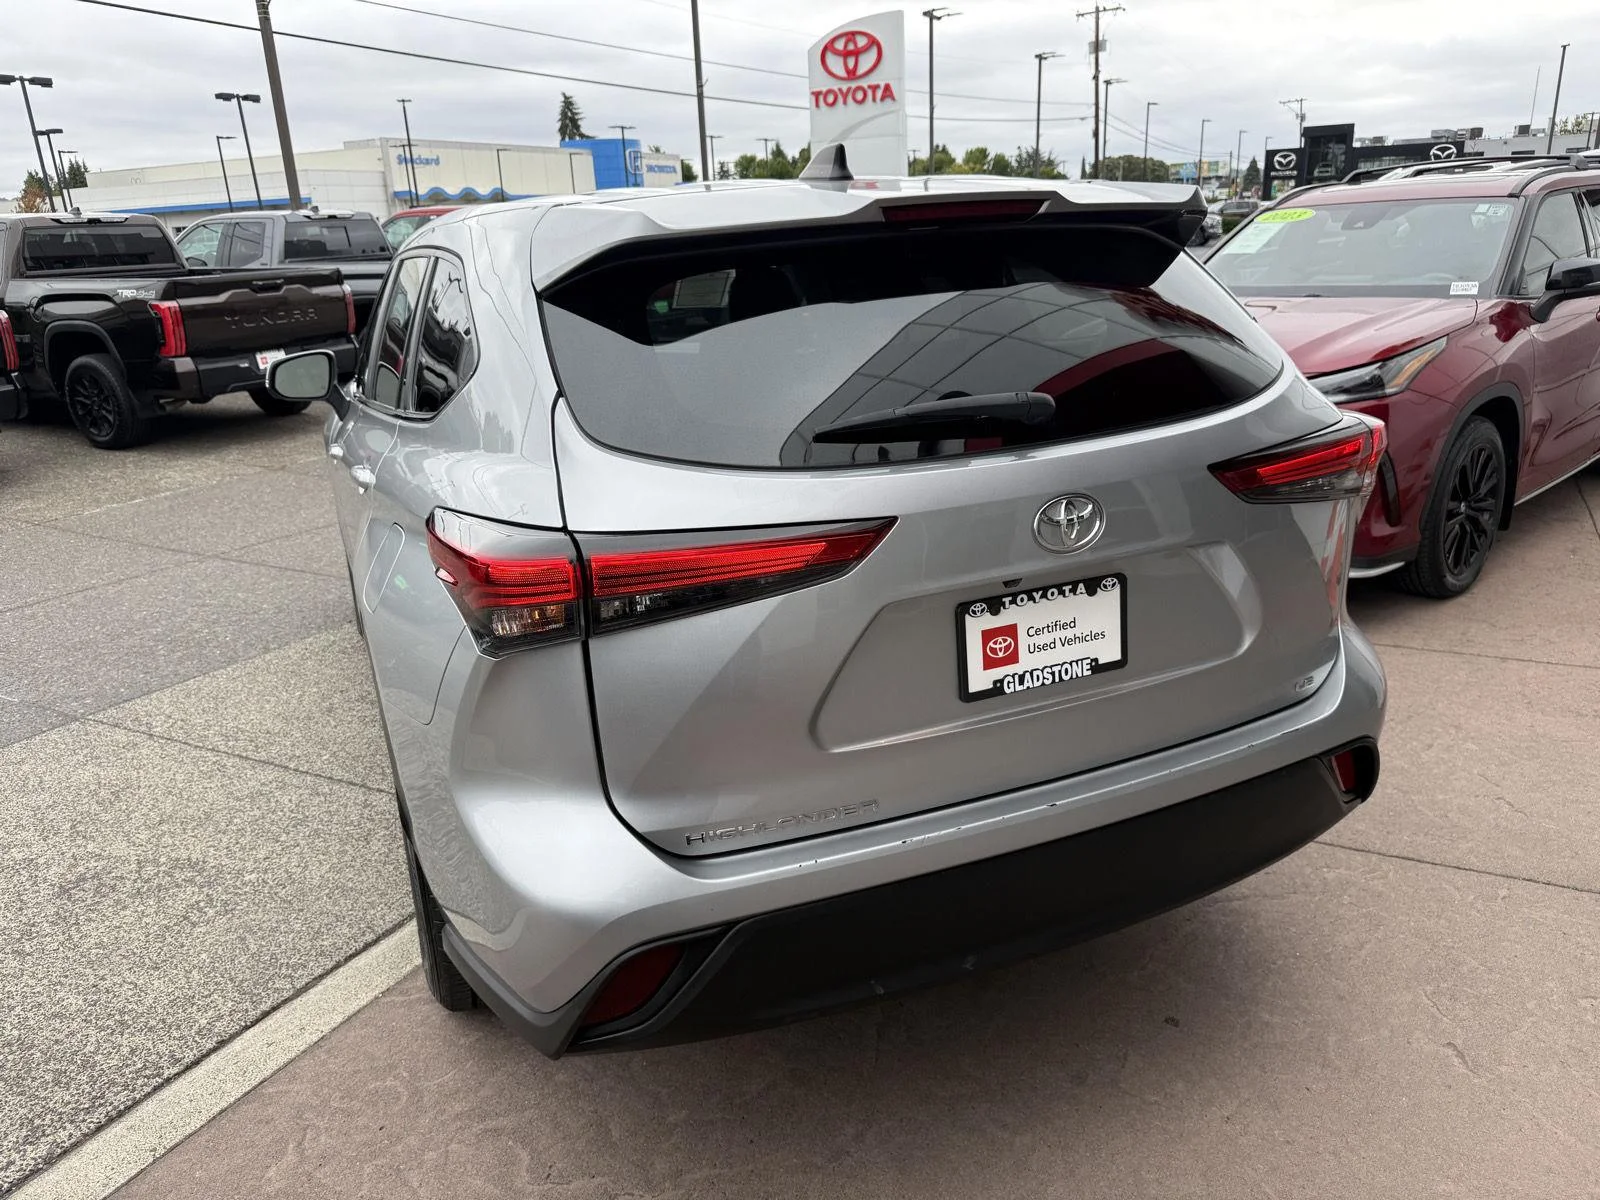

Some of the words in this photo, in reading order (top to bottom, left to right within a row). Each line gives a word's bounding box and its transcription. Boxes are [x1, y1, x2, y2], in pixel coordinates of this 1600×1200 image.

[811, 82, 896, 109] TOYOTA
[1002, 583, 1087, 610] TOYOTA
[1026, 617, 1077, 638] Certified
[1027, 637, 1057, 654] Used
[1059, 629, 1106, 648] Vehicles
[1003, 659, 1092, 694] GLADSTONE
[684, 799, 880, 847] HIGHLANDER
